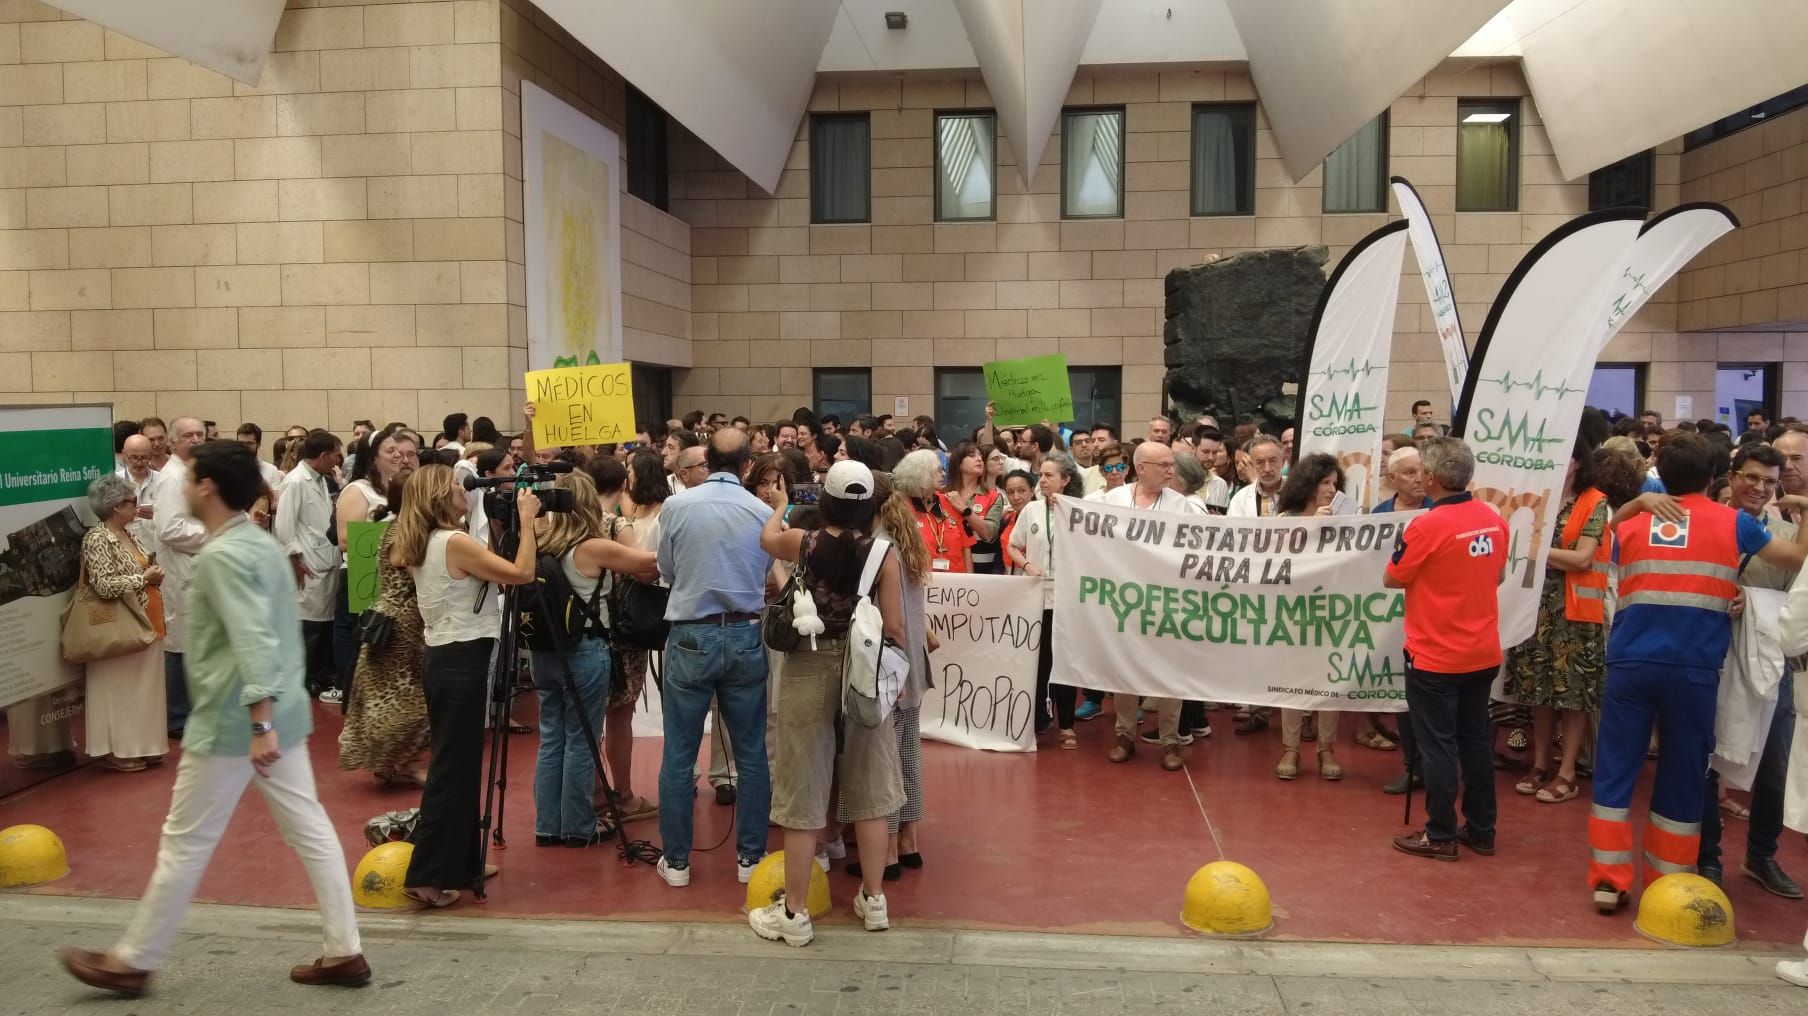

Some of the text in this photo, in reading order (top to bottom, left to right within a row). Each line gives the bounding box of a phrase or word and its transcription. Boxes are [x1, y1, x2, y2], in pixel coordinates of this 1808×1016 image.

[537, 372, 629, 403] MÉDICOS
[568, 402, 593, 425] EN
[1309, 391, 1370, 421] SMA
[545, 423, 623, 444] HUELGA
[1312, 421, 1377, 437] CÓRDOBA
[1473, 408, 1556, 454] SMA
[1476, 447, 1556, 471] CÓRDOBA
[4, 469, 59, 489] Universitario
[59, 466, 82, 483] Reina
[1069, 507, 1118, 539] POR
[1126, 517, 1166, 545] UN
[1173, 523, 1308, 554] ESTATUTO
[1179, 553, 1292, 585] PARA LA
[926, 587, 980, 607] EMPO
[1079, 574, 1406, 623] PROFESIÓN MÉDICA
[1110, 604, 1375, 650] Y FACULTATIVA
[1327, 649, 1395, 689] SMA
[940, 663, 1031, 741] PROPIO
[1267, 685, 1306, 695] SINDICATO
[1304, 688, 1330, 697] MÉDICO
